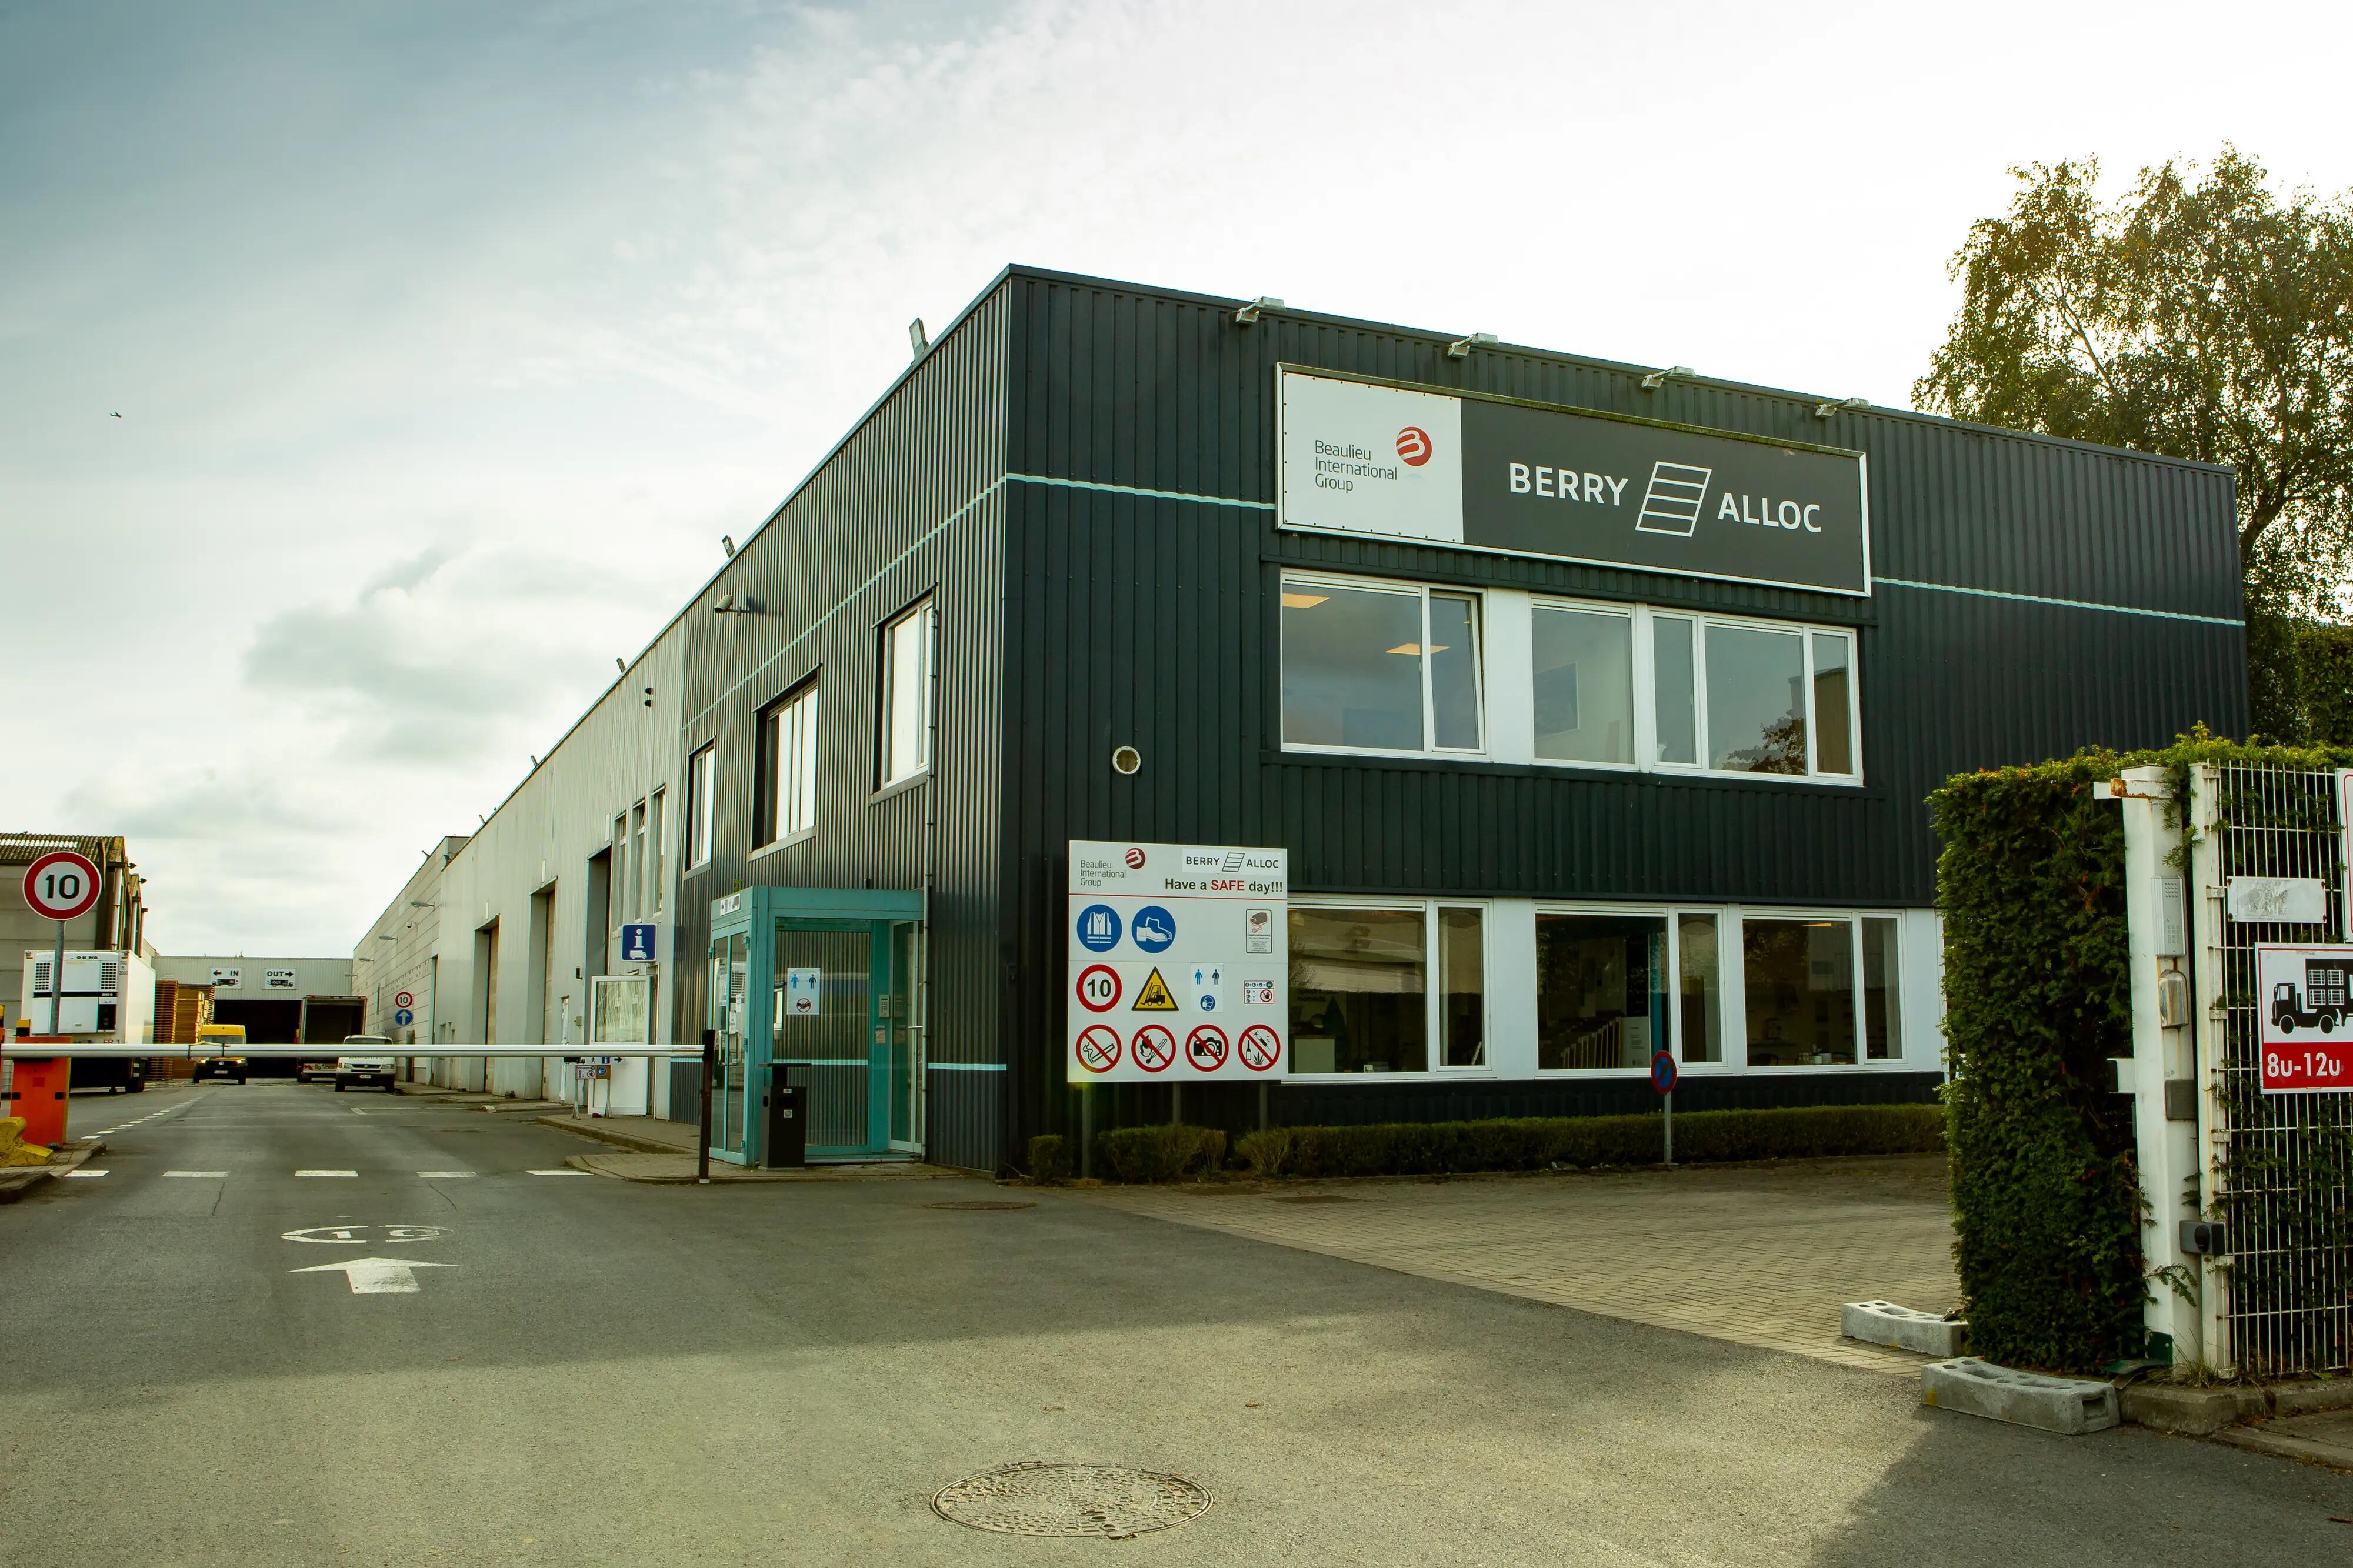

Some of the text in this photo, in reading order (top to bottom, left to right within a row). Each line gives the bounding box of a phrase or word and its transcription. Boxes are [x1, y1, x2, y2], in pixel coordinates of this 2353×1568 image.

[1315, 439, 1371, 461] Beaulieu
[1315, 456, 1398, 481] International
[1315, 473, 1354, 494] Group
[1509, 462, 1822, 533] BERRY ALLOC
[1080, 859, 1112, 869] Beaulieu
[1185, 856, 1279, 869] BERRY ALLOC
[1080, 869, 1126, 878] International
[1080, 878, 1102, 888] Group
[45, 874, 80, 899] 10
[1165, 878, 1282, 895] Have a SAFE day!!!
[1087, 979, 1111, 997] 10
[2267, 1052, 2341, 1077] 8u-12u
